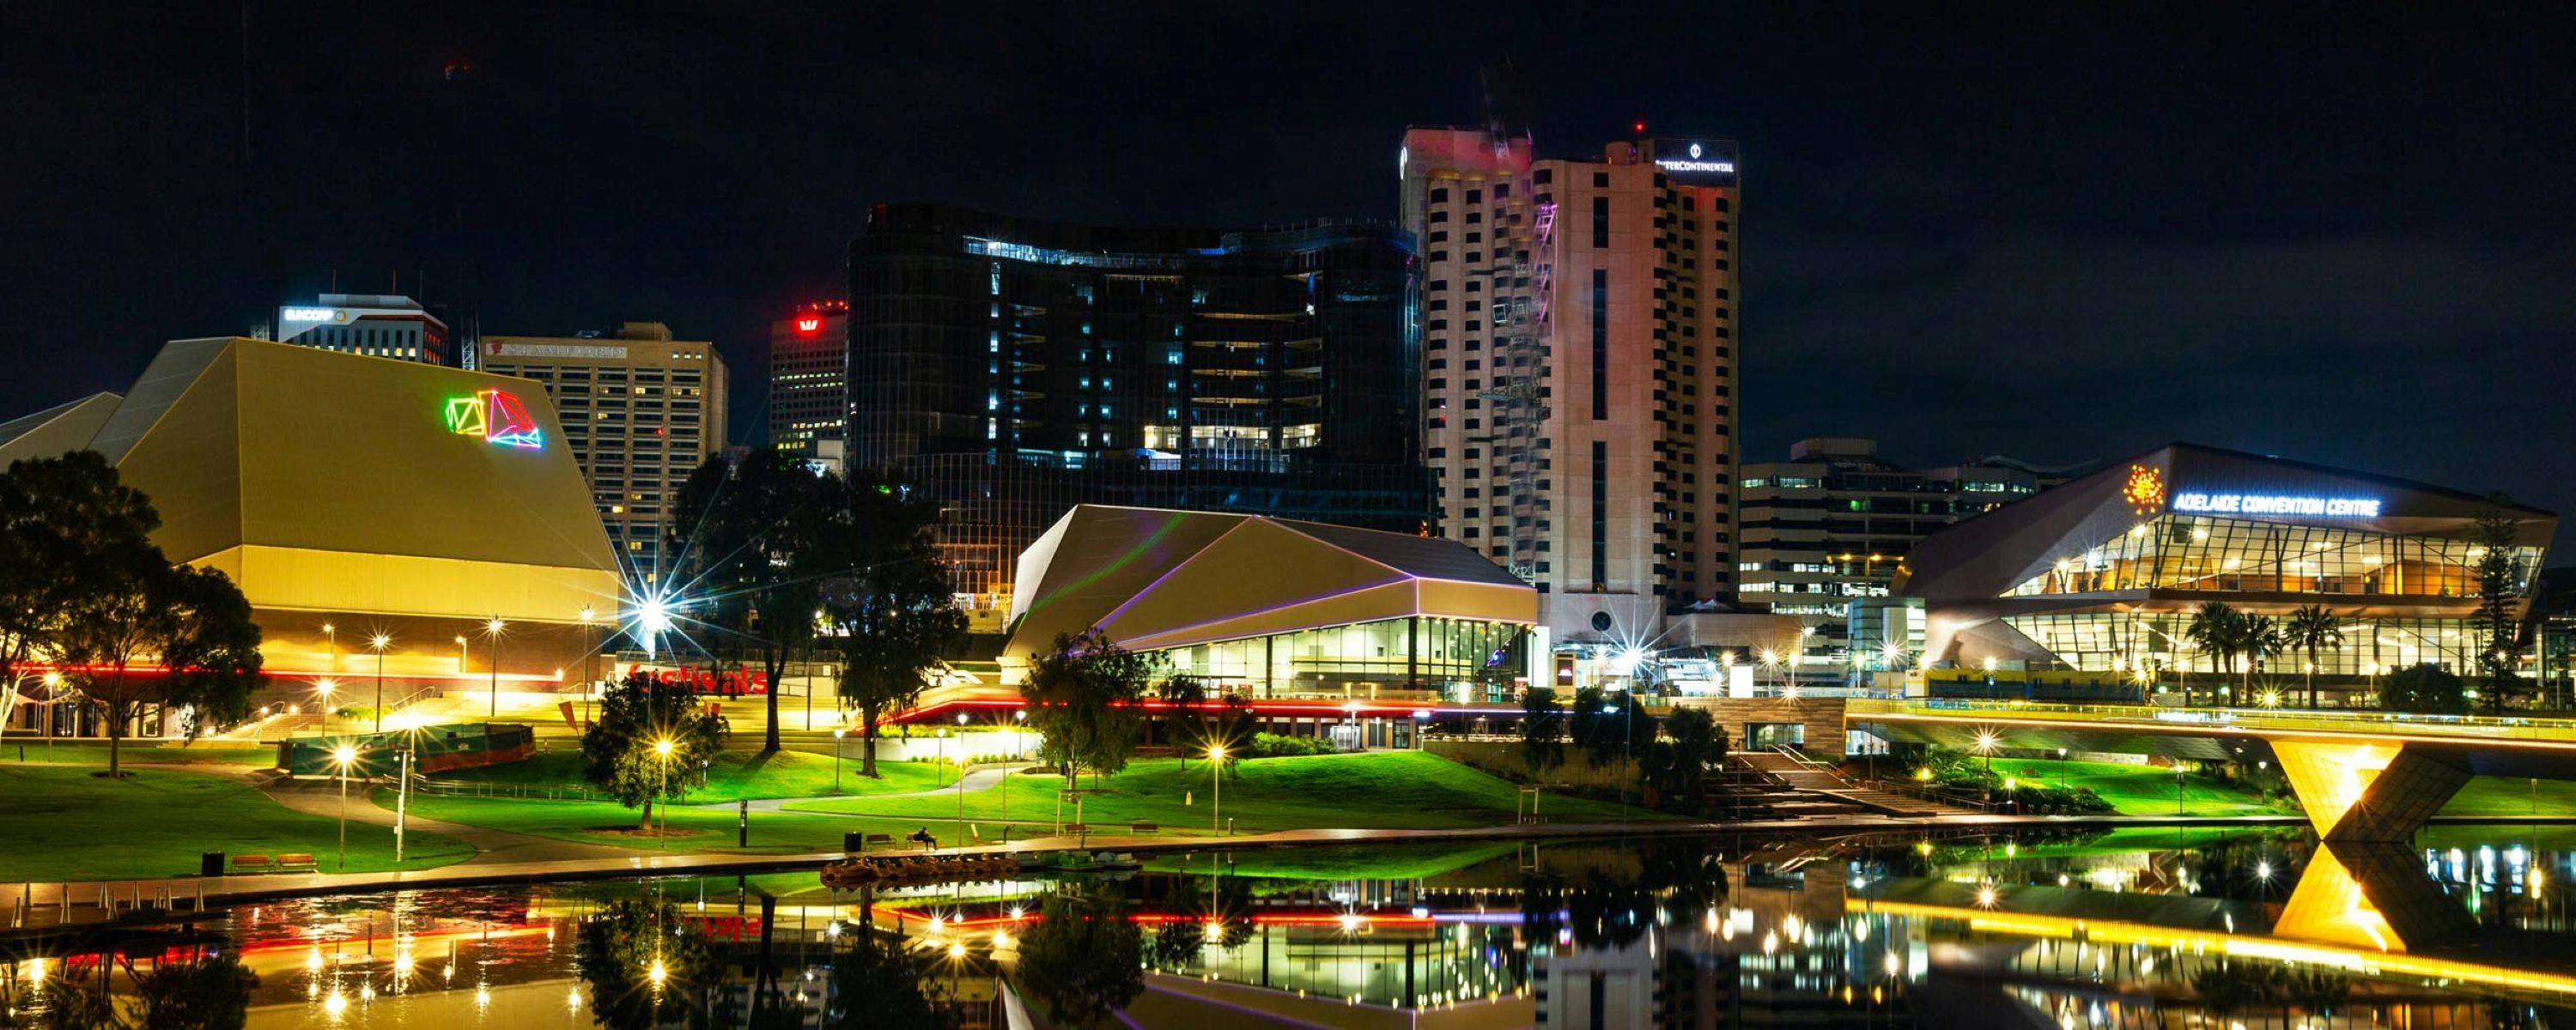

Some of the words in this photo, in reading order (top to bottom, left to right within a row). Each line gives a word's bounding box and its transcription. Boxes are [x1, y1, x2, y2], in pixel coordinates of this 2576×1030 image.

[2174, 494, 2240, 512] ADELAIDE
[2241, 496, 2325, 514] CONVENTION
[2325, 499, 2380, 517] CENTRE
[629, 663, 768, 694] fstivals
